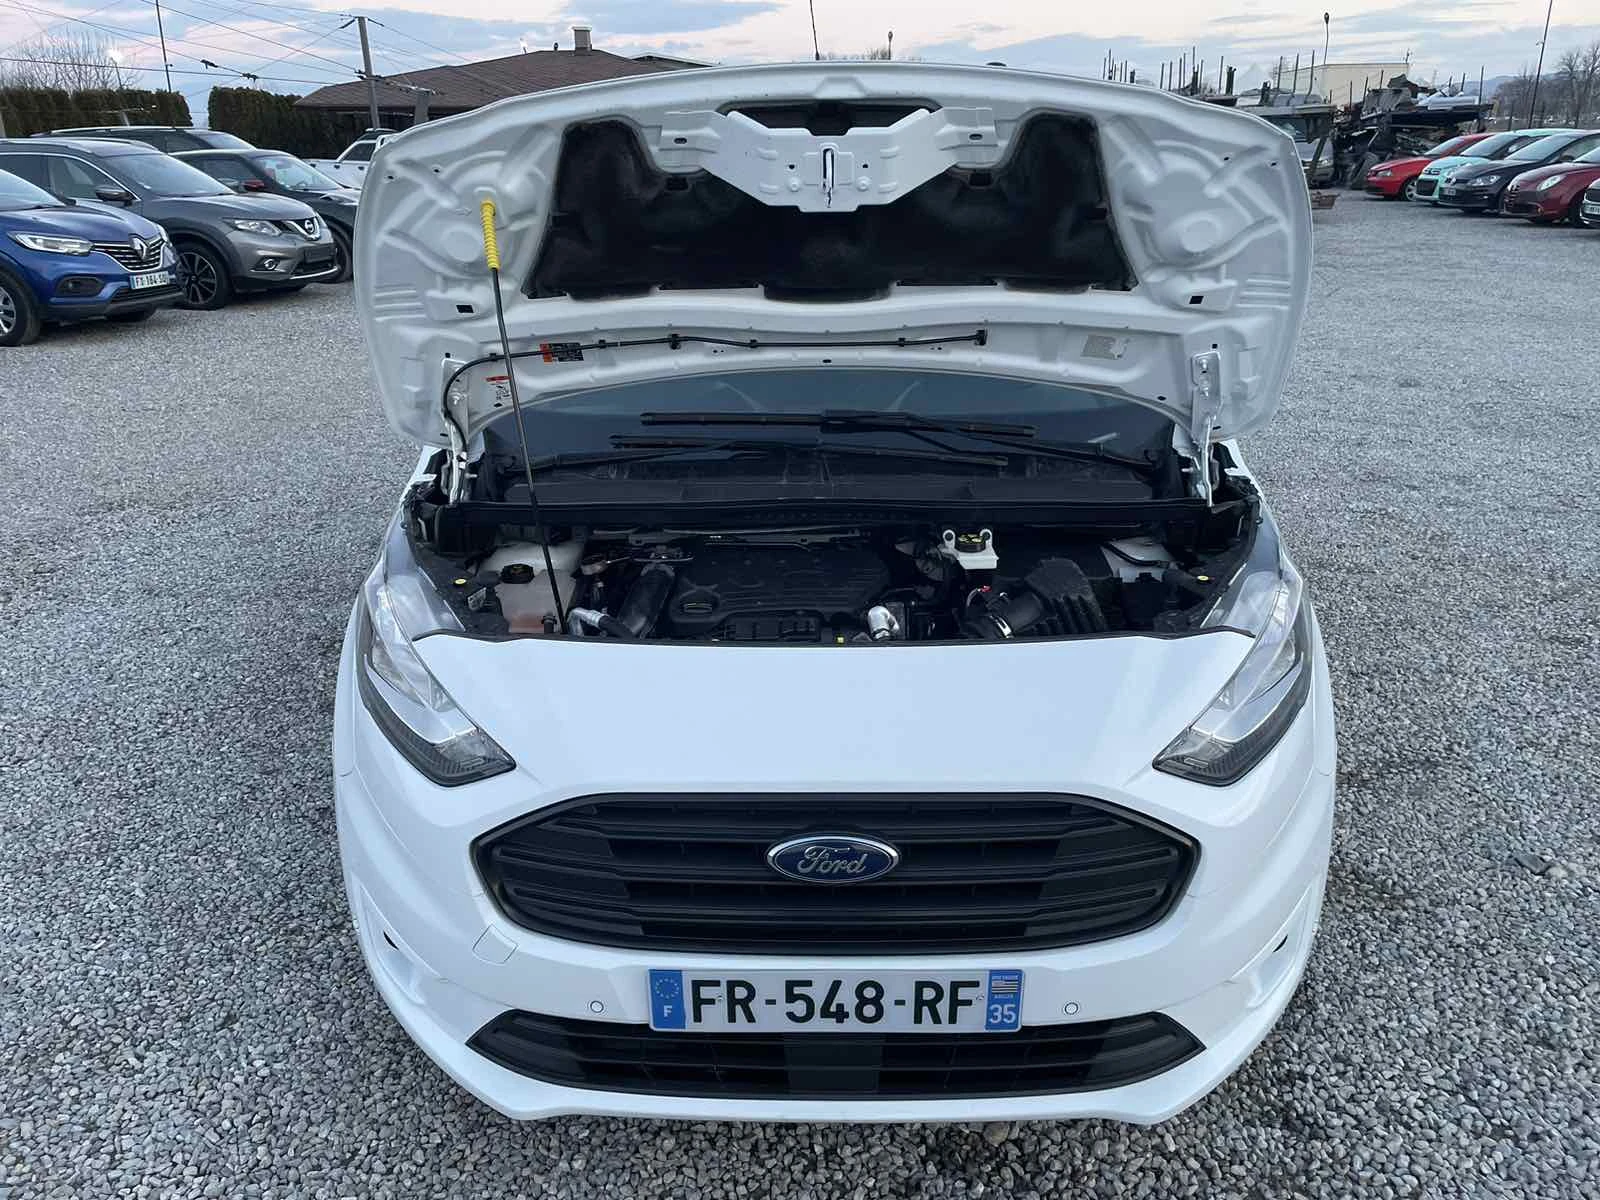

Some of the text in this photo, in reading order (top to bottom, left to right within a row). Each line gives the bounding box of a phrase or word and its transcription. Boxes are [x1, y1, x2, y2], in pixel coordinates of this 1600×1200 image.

[797, 845, 868, 874] Ford
[664, 1005, 673, 1018] F
[691, 979, 980, 1025] FR-548-RF
[989, 1004, 1016, 1024] 35
